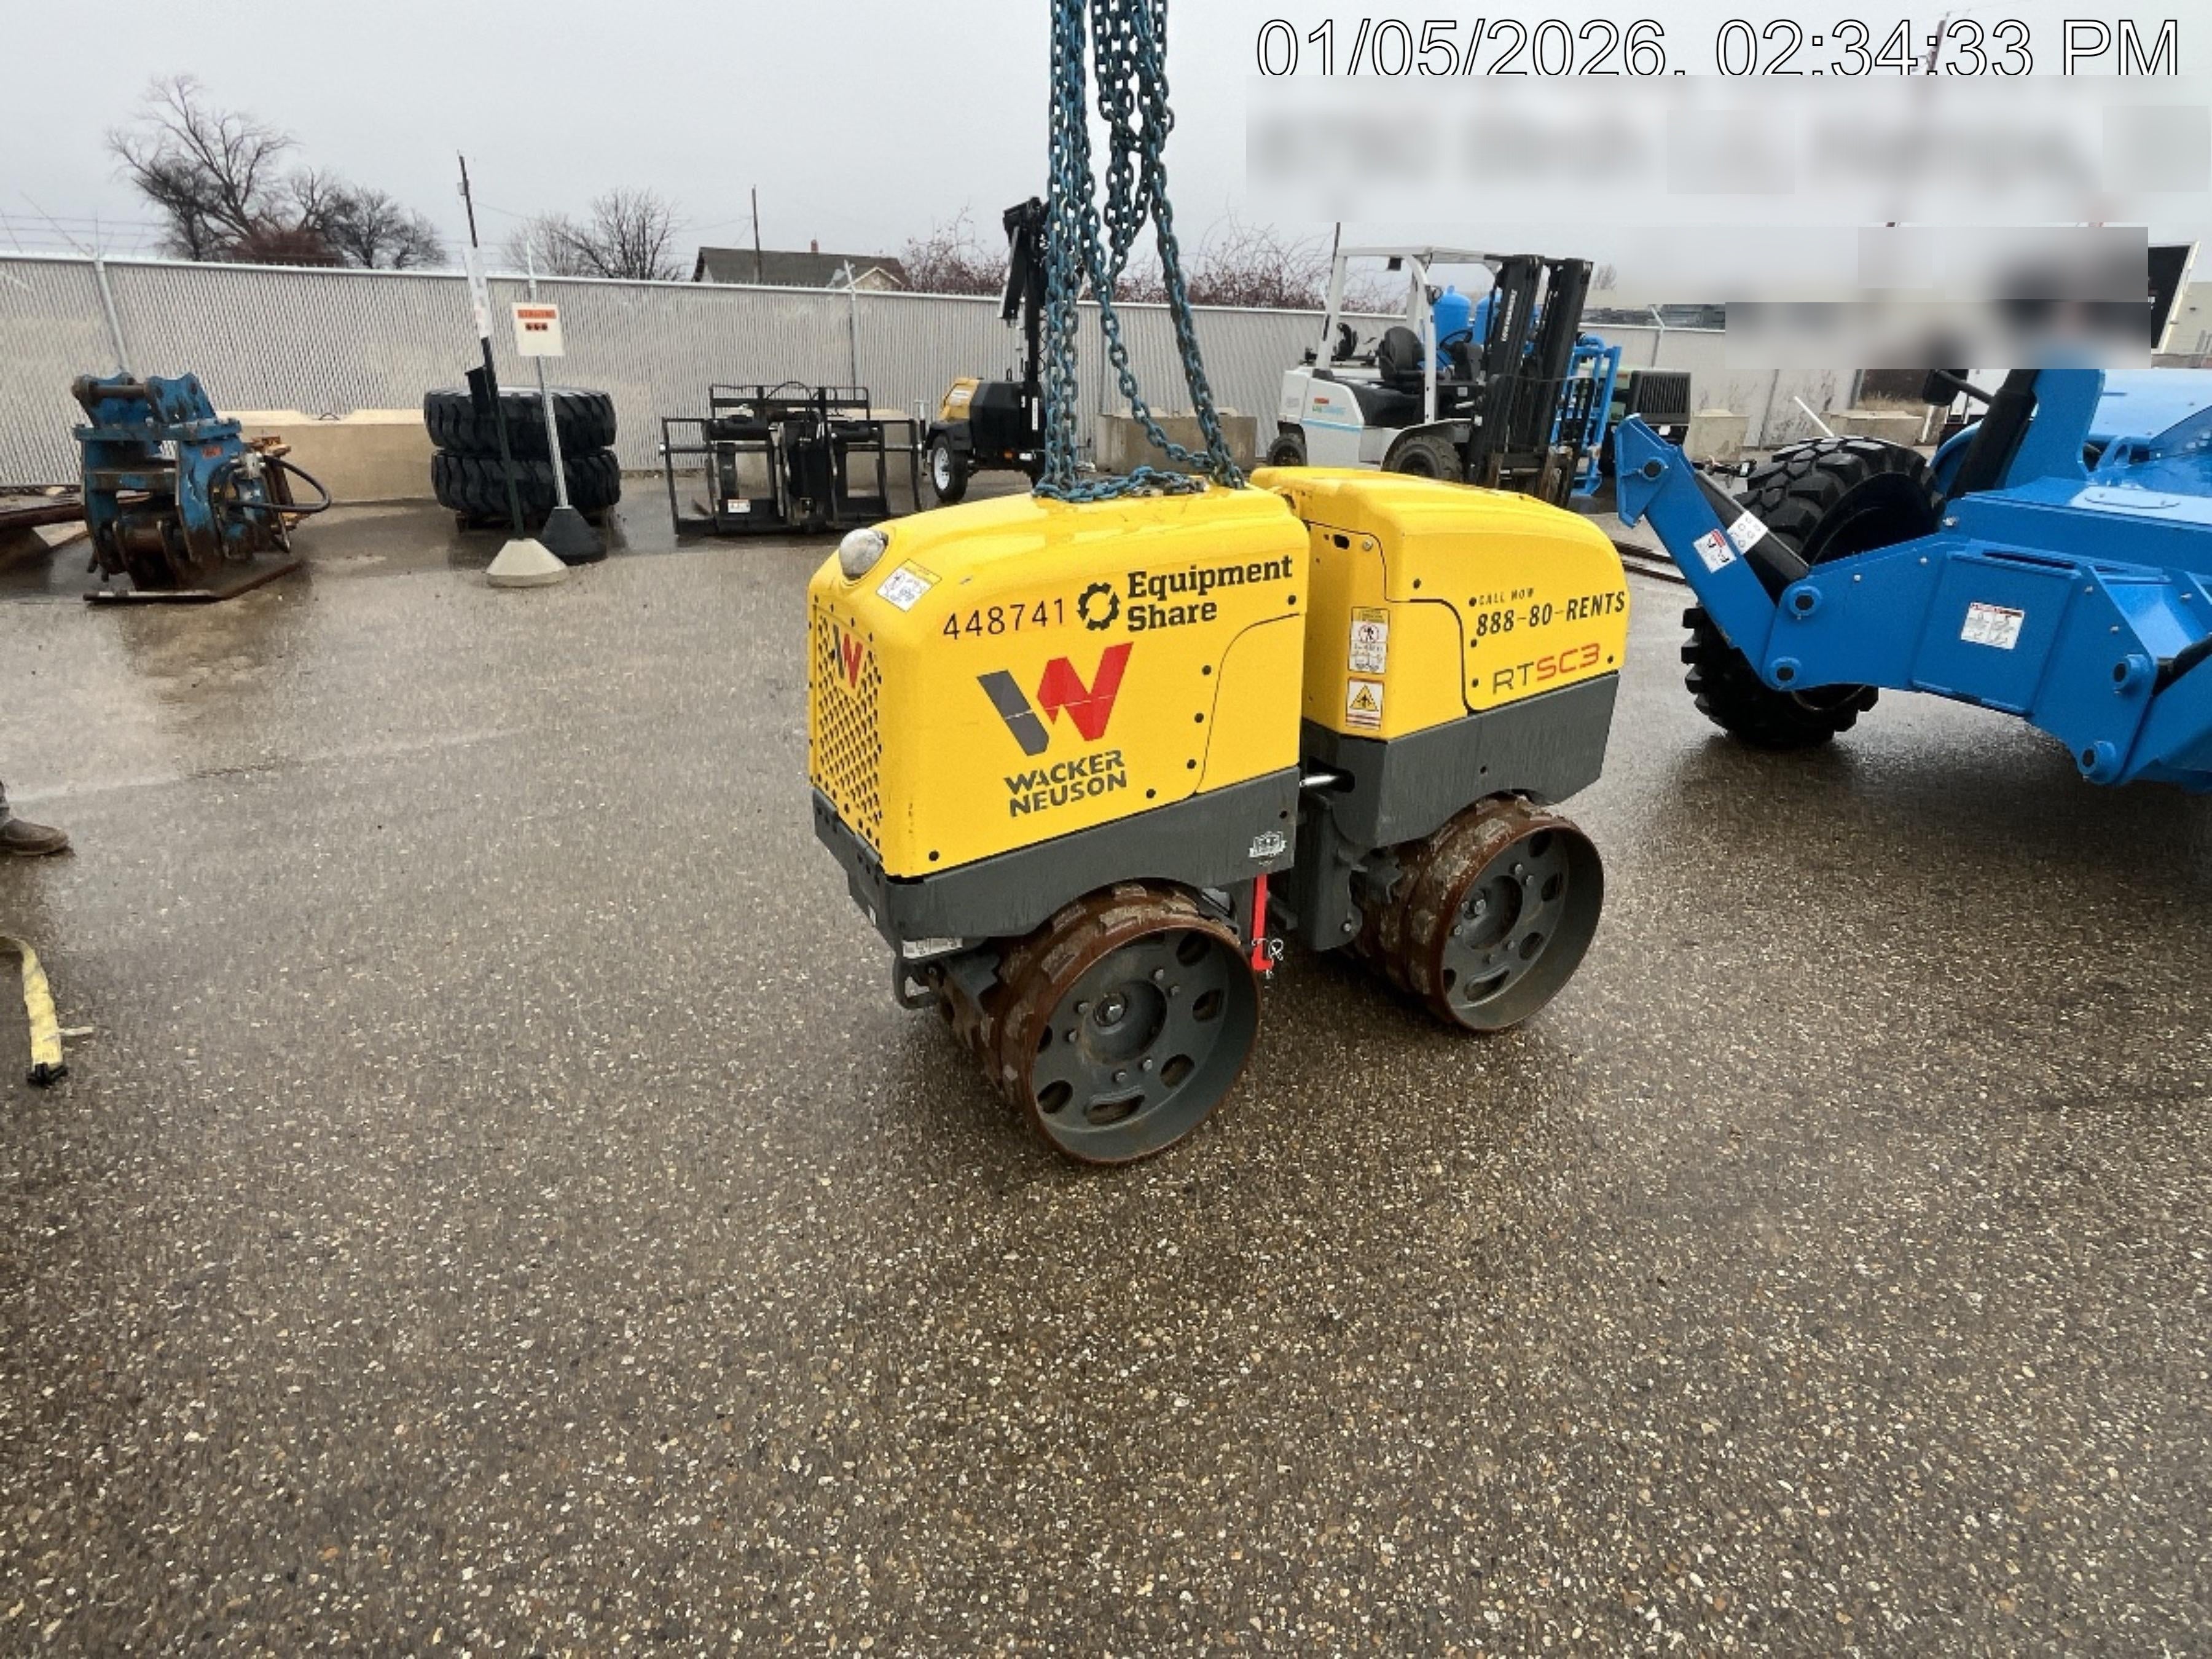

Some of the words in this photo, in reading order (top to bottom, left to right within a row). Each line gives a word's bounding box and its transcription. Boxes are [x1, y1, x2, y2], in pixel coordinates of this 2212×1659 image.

[1128, 555, 1293, 600] Equipment
[1478, 592, 1505, 606] CALL
[943, 598, 1065, 640] 448741
[1128, 600, 1217, 632] Share
[1476, 590, 1625, 637] 888-80-RENTS
[1493, 643, 1601, 695] RTSC3
[1003, 750, 1125, 795] WACKER
[1009, 771, 1127, 817] NEUSON
